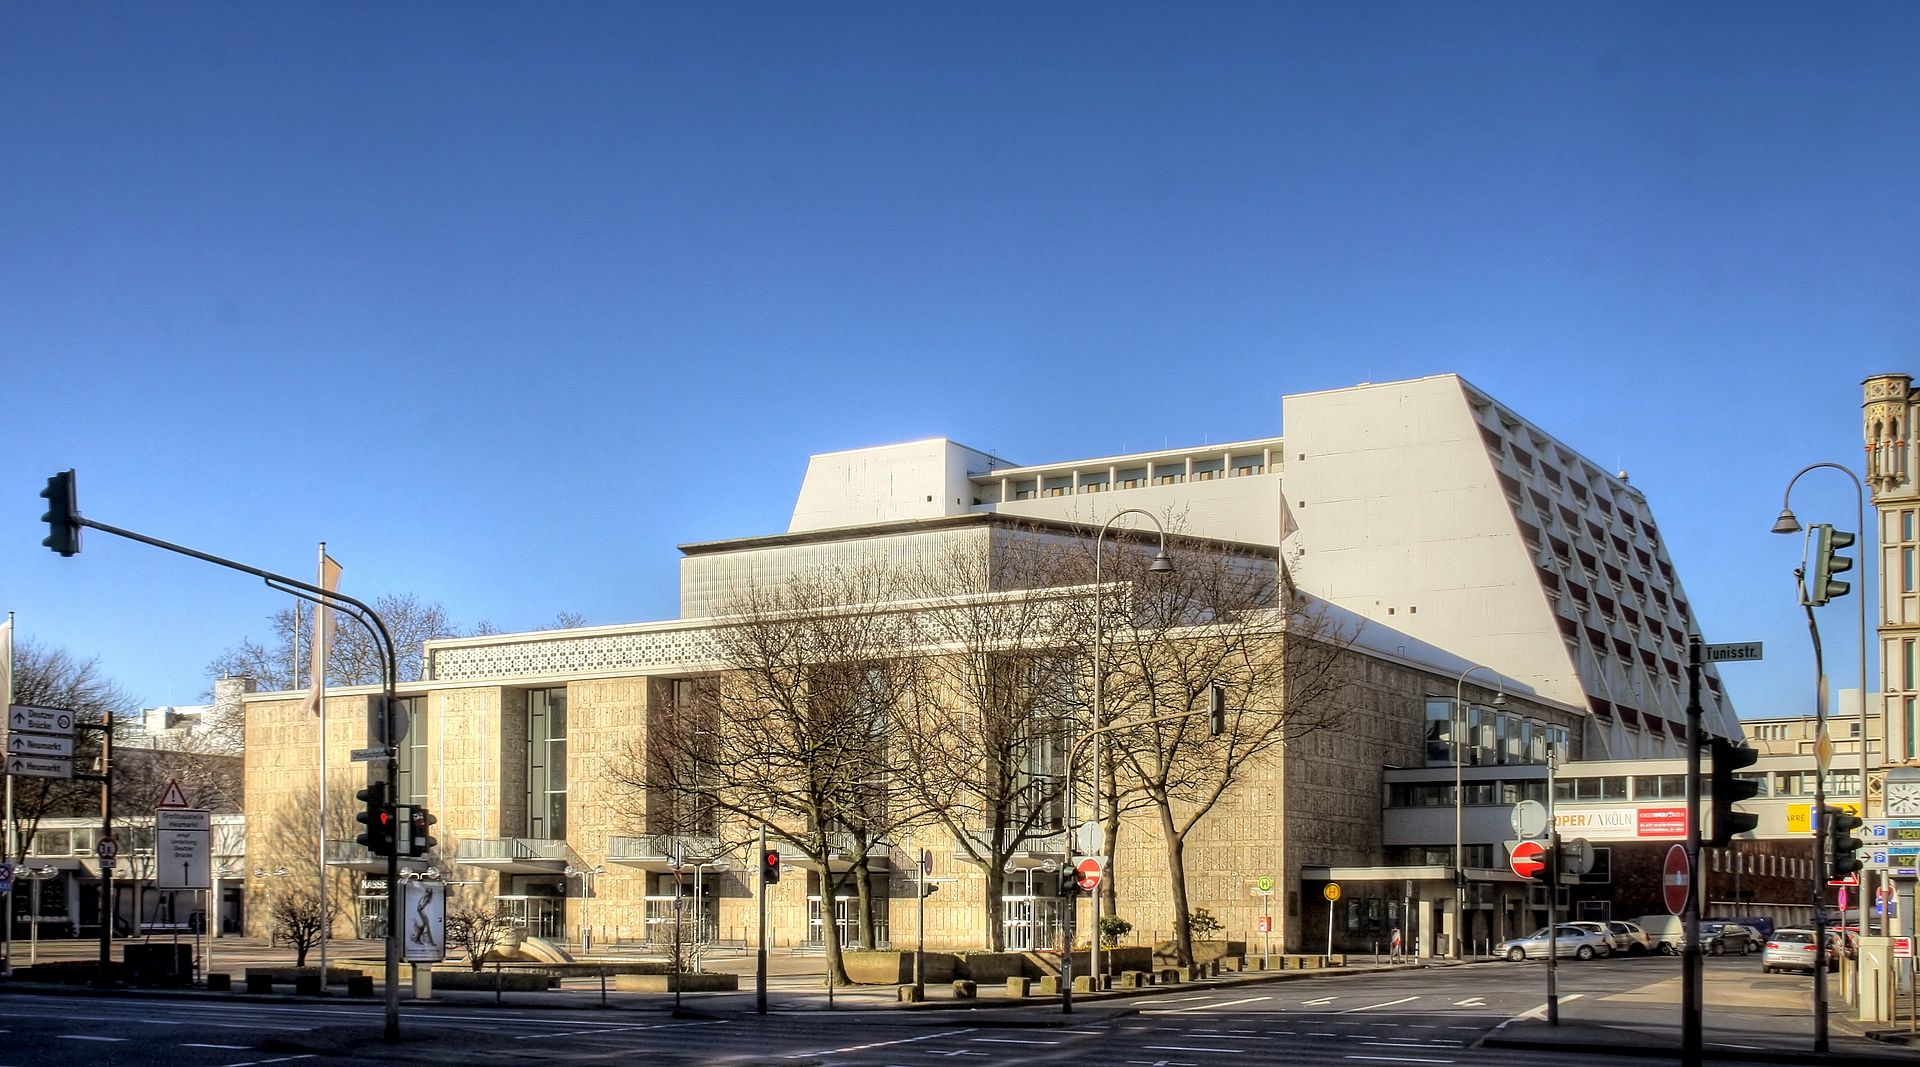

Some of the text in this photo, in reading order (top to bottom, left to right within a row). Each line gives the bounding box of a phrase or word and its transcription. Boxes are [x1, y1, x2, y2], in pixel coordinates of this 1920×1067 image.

[1706, 646, 1757, 660] Tunisstr.
[28, 709, 55, 719] Deutzer
[361, 879, 388, 889] KASSE
